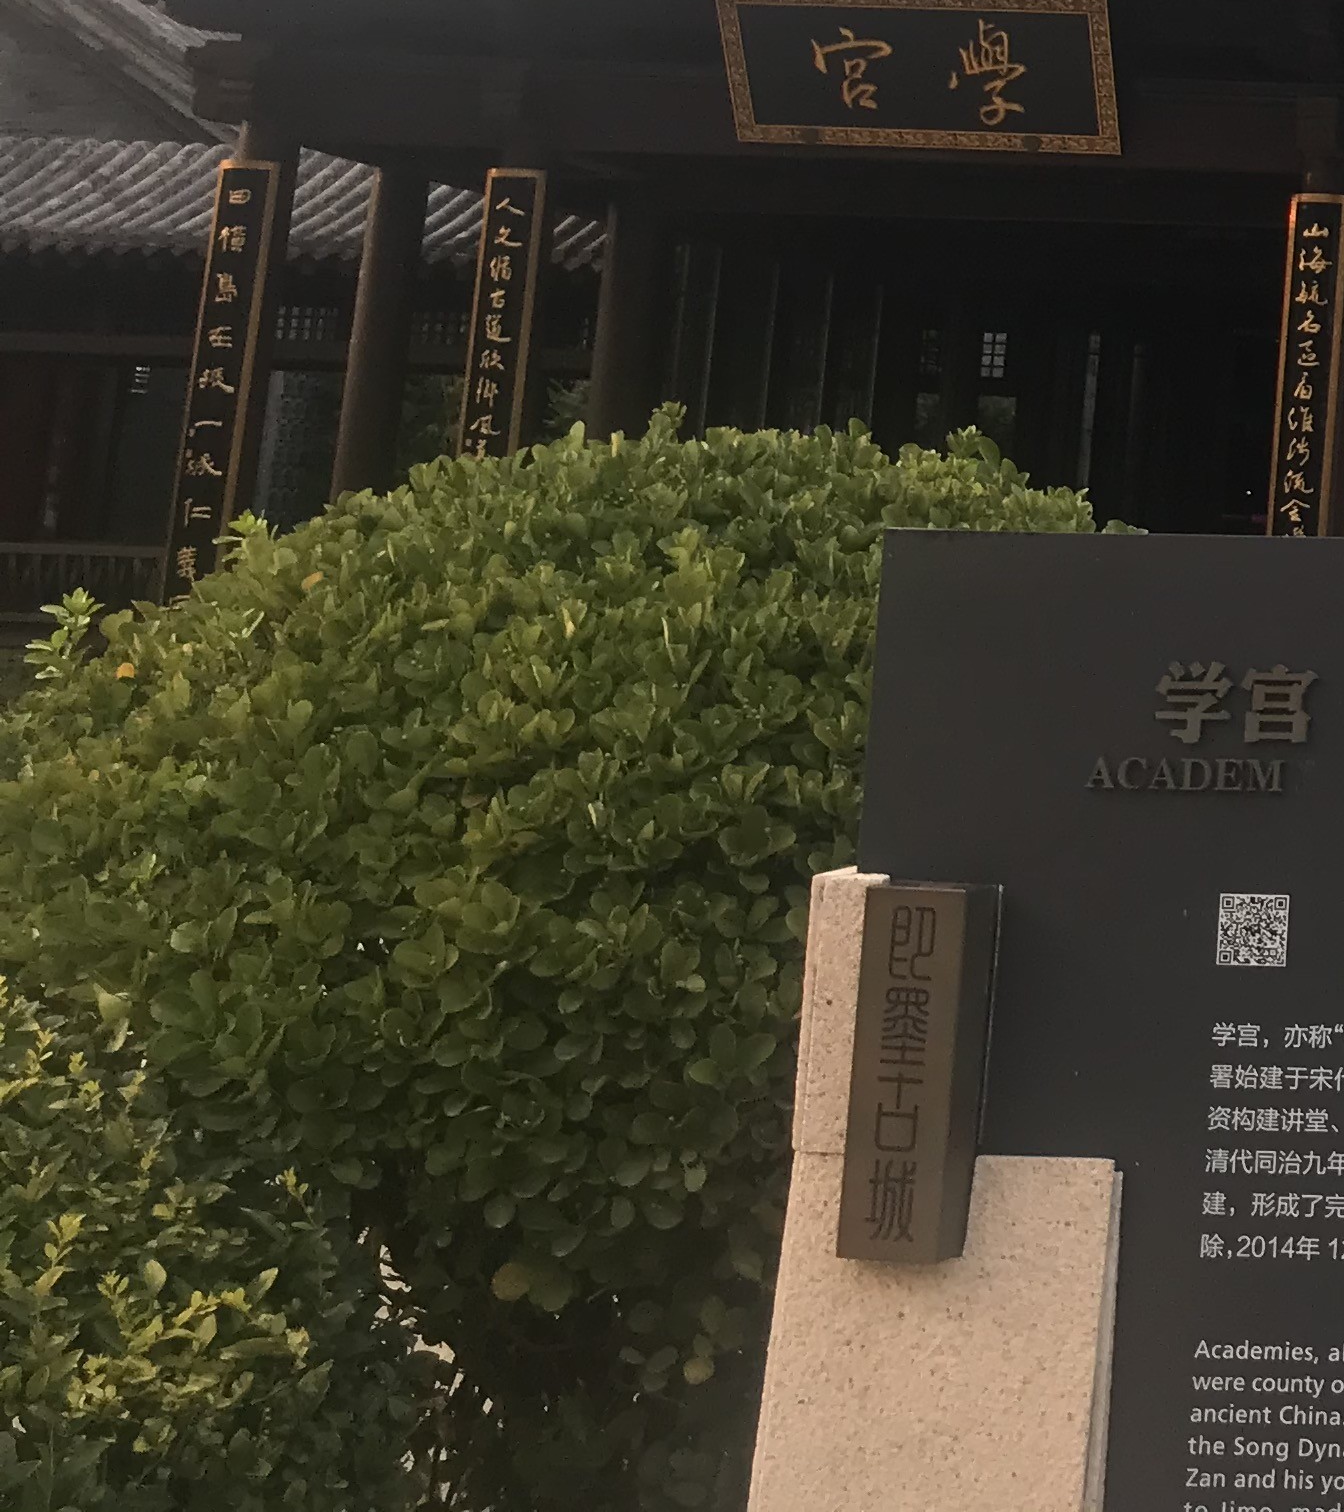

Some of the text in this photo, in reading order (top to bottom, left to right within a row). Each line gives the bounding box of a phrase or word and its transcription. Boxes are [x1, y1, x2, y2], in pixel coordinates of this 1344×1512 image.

[1155, 661, 1319, 744] 学宫
[1194, 1340, 1319, 1364] Academies,
[1192, 1375, 1245, 1392] were
[1252, 1375, 1325, 1398] county
[1190, 1404, 1272, 1424] ancient
[1187, 1435, 1225, 1456] the
[1233, 1436, 1289, 1462] Song
[1185, 1468, 1226, 1488] Zan
[1234, 1468, 1276, 1489] and
[1283, 1469, 1314, 1490] his
